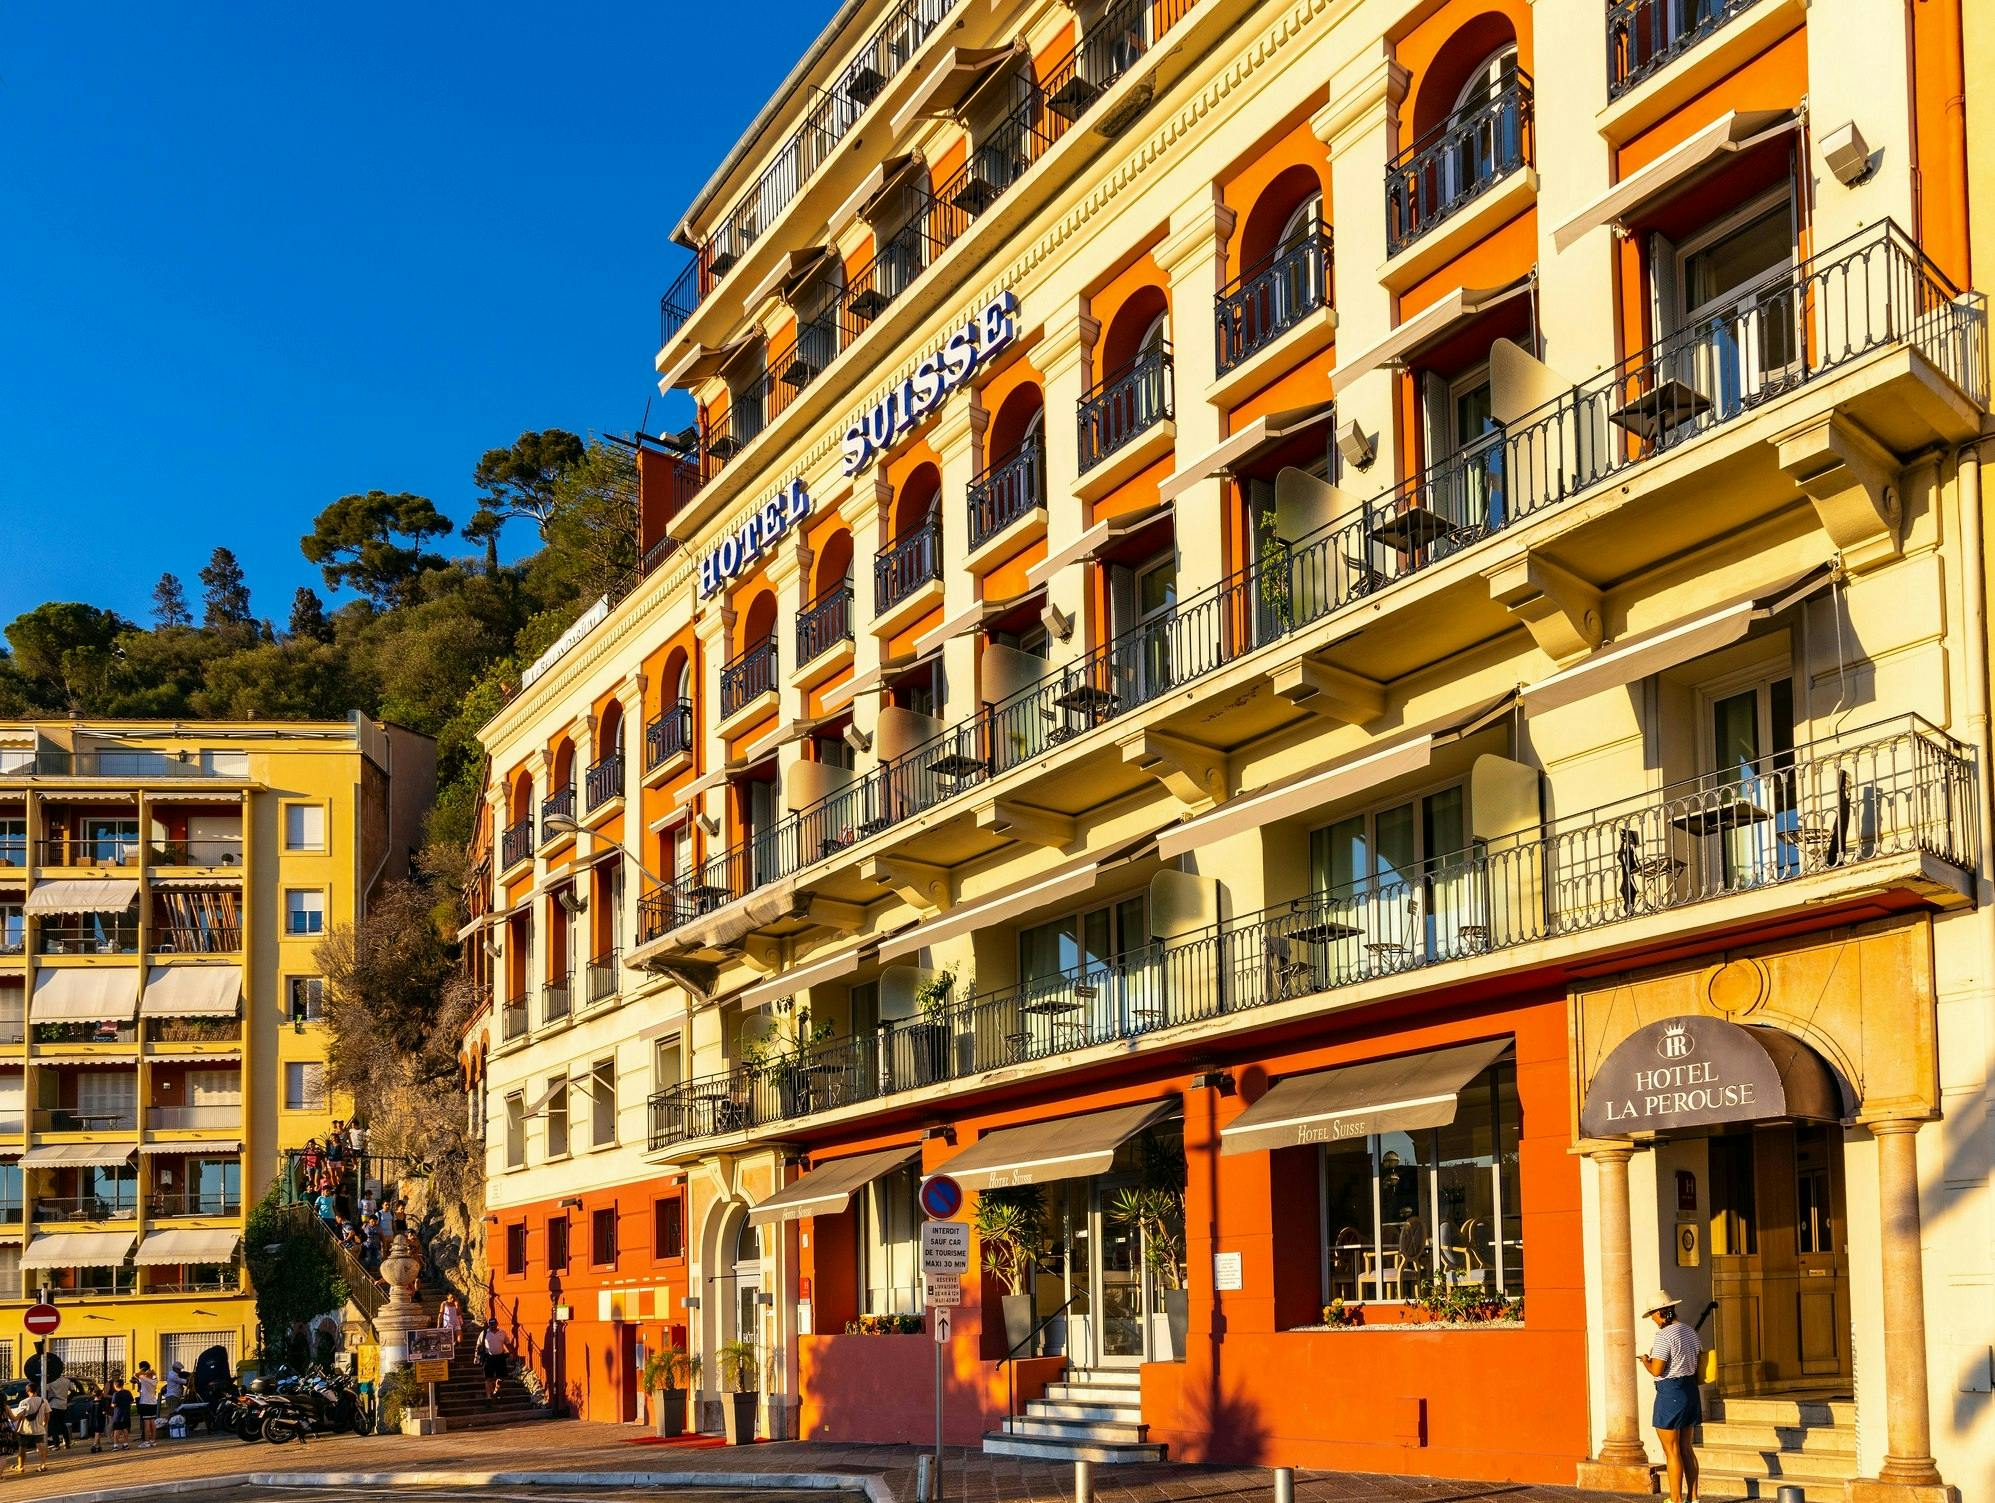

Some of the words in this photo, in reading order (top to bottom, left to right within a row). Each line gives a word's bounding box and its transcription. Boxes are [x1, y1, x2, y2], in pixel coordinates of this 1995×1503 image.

[699, 477, 810, 600] HOTEL
[841, 290, 1019, 477] SUISSE
[1636, 1061, 1720, 1092] HOTEL
[1606, 1100, 1639, 1121] LA
[1645, 1084, 1755, 1116] PEROUSE
[932, 1227, 960, 1235] INTERDIT
